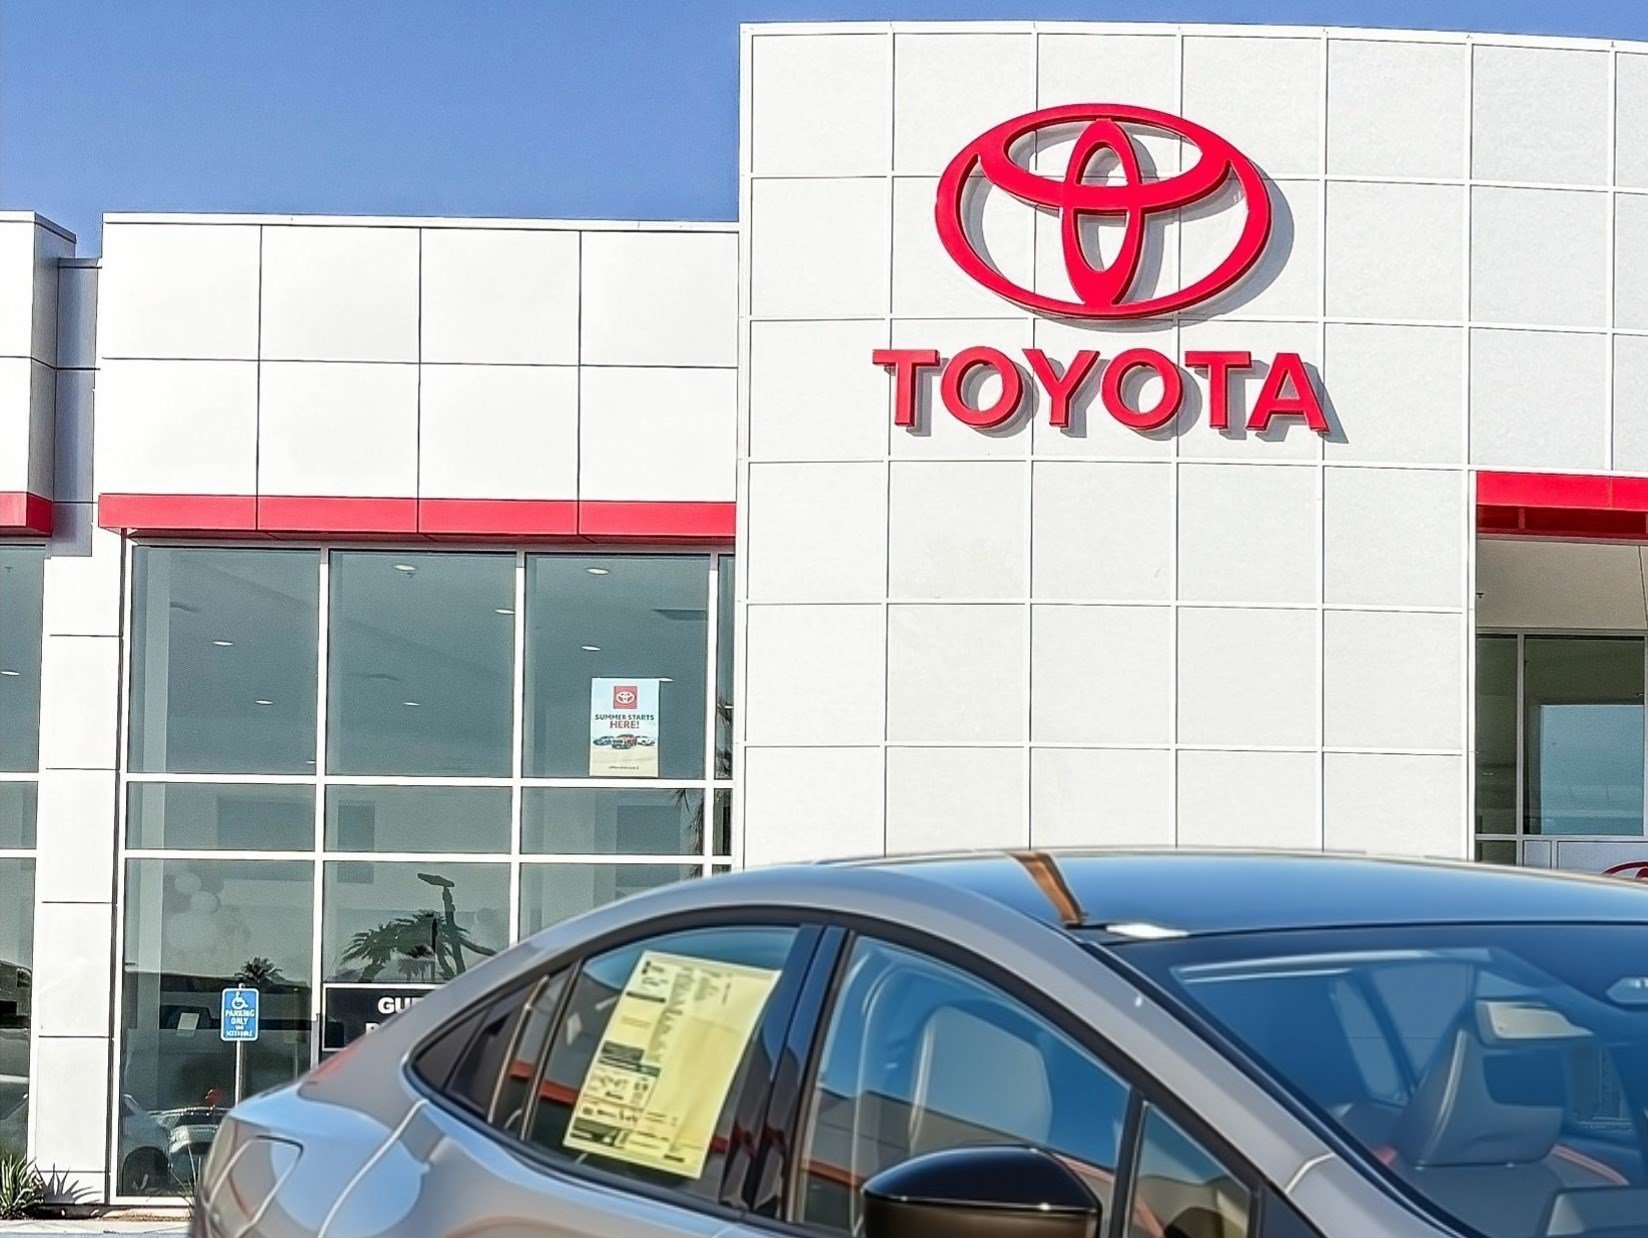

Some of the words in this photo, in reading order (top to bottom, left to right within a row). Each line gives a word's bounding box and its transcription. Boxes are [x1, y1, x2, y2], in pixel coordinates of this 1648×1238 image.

[872, 345, 1330, 434] TOYOTA
[609, 721, 640, 729] HERE!
[225, 1009, 255, 1017] PARKING
